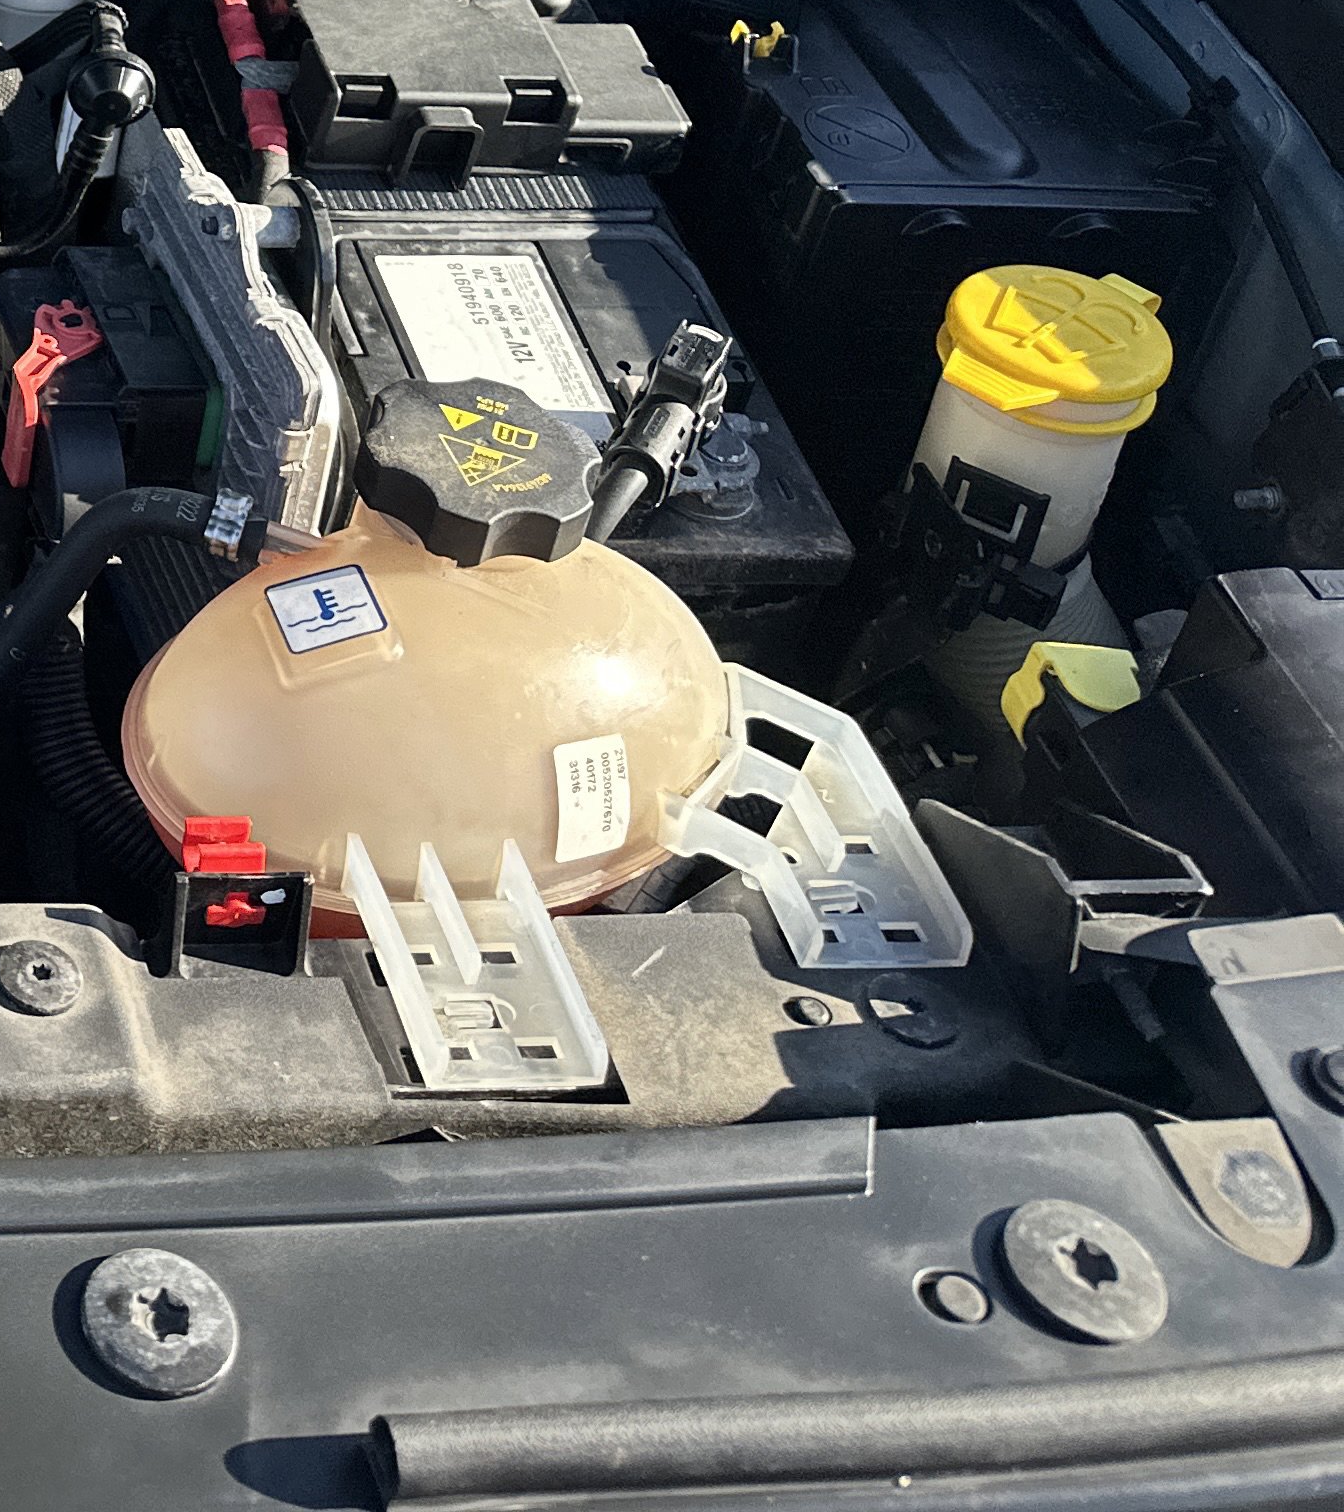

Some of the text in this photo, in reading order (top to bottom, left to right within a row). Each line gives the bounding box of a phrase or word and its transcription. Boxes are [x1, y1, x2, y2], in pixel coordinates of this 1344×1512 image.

[471, 268, 489, 281] 70
[489, 266, 508, 283] 640
[446, 262, 490, 325] 51940918
[507, 304, 526, 322] 120
[505, 340, 536, 364] 12V
[569, 760, 581, 794] 31316
[586, 757, 597, 793] 40172
[601, 752, 613, 832] 00520527670
